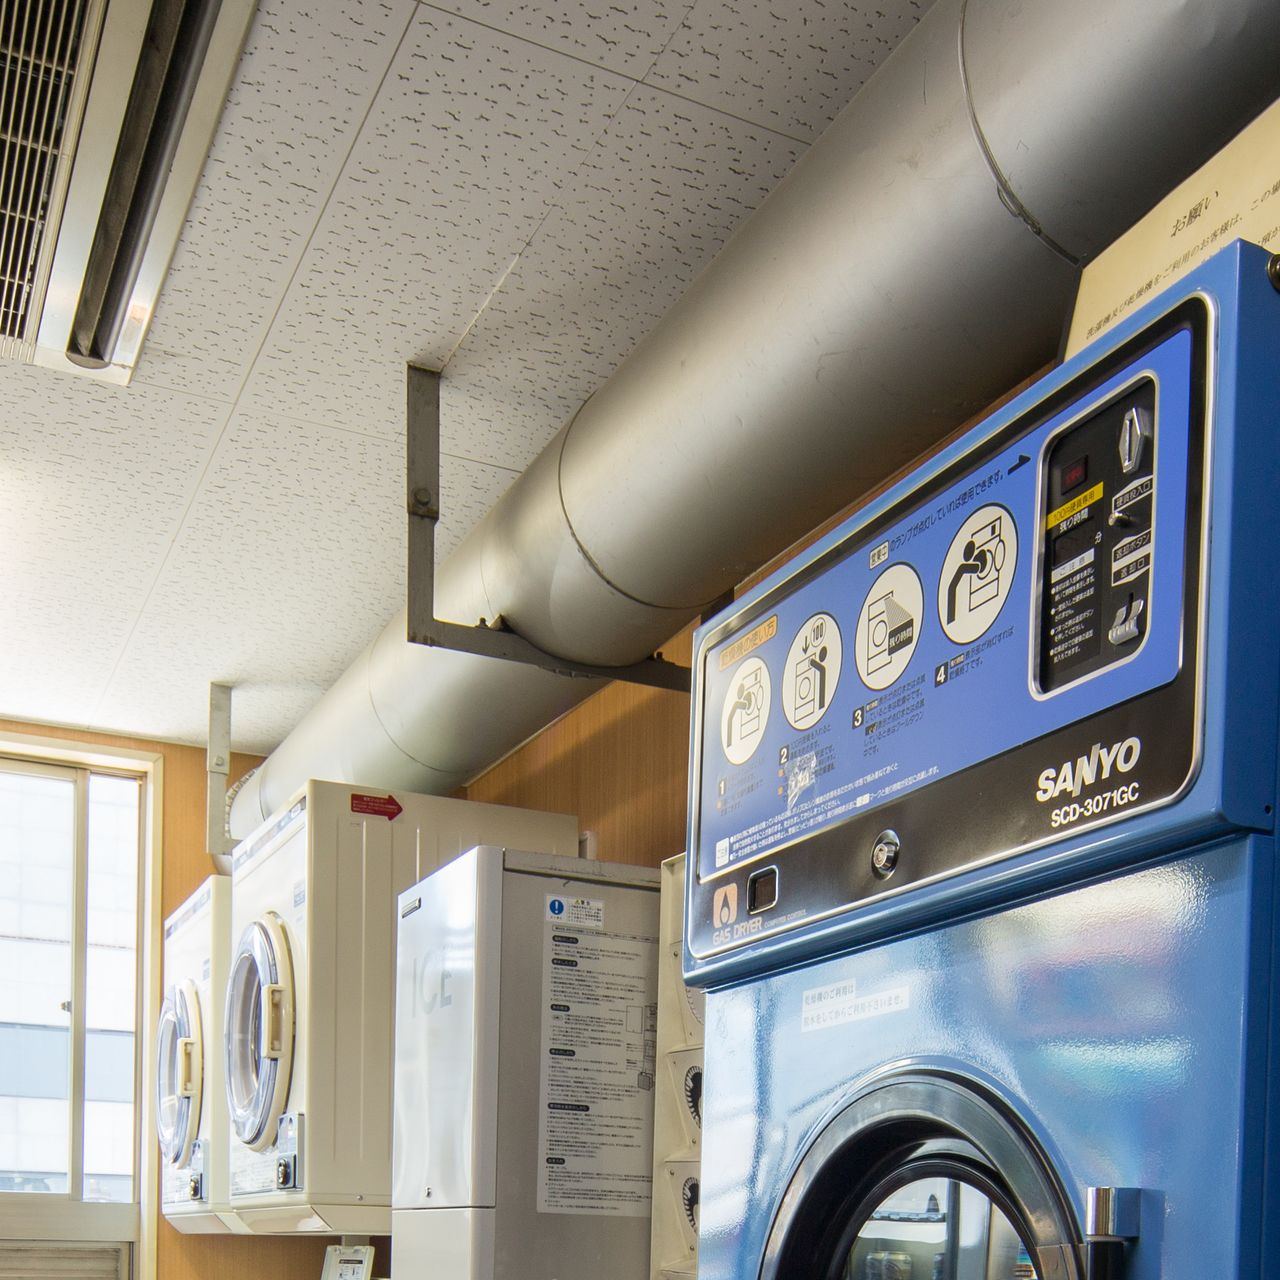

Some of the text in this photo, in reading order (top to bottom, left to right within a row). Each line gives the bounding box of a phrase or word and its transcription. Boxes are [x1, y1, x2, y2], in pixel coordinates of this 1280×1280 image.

[1171, 190, 1219, 237] お願い
[1060, 508, 1089, 533] 残り時間
[812, 622, 824, 642] 100
[936, 666, 946, 683] 4
[854, 710, 862, 727] 3
[780, 749, 787, 764] 2
[1036, 737, 1141, 802] SANYO
[1051, 782, 1140, 828] SCD-3071GC
[713, 928, 730, 946] GAS
[733, 916, 762, 940] DRYER
